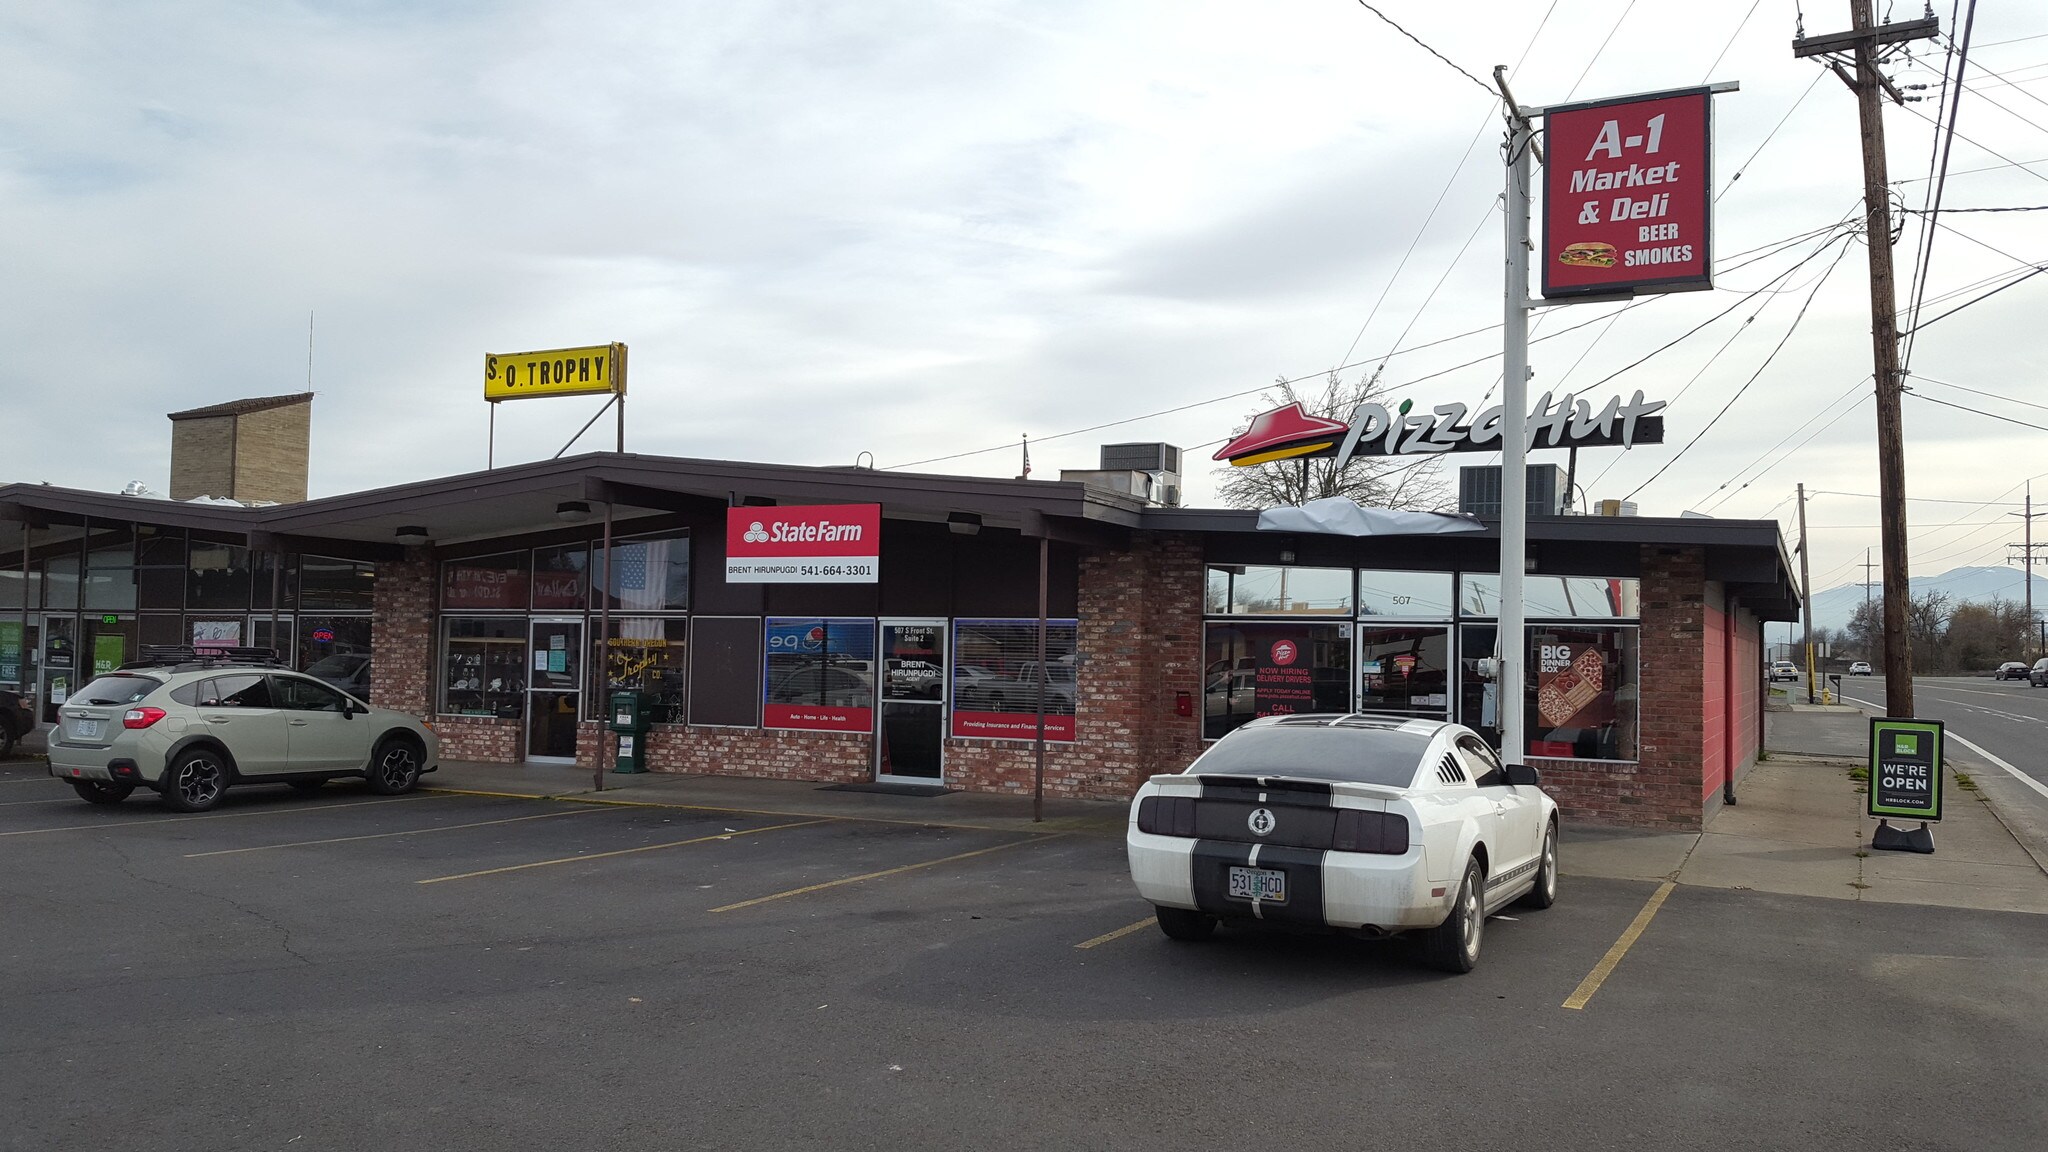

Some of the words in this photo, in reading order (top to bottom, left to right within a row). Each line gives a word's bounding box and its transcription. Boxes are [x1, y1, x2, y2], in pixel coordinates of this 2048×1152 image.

[1585, 114, 1666, 162] A-1
[1569, 161, 1681, 194] Market
[1578, 200, 1601, 225] &
[1610, 192, 1670, 222] Deli
[1639, 222, 1679, 243] BEER
[1624, 244, 1693, 267] SMOKES
[527, 356, 604, 386] TROPHY
[1336, 398, 1504, 469] Pizza
[1526, 389, 1667, 454] Hut
[728, 566, 752, 574] BRENT
[754, 566, 798, 574] HIRUNPUGDI
[800, 565, 872, 576] 541-664-3301
[1393, 596, 1411, 605] 507
[102, 615, 117, 624] OPEN
[312, 631, 335, 640] OPEN
[904, 634, 919, 642] Suite
[920, 634, 924, 642] 2
[607, 638, 640, 647] SOUTHERN
[642, 638, 667, 648] OREGON
[1541, 645, 1571, 660] BIG
[95, 660, 112, 669] H&R
[616, 652, 657, 681] Trophy
[901, 660, 926, 668] BRENT
[1541, 659, 1571, 667] DINNER
[2, 665, 16, 676] FREE
[891, 669, 936, 677] HIRUNPUGDI
[1259, 667, 1279, 675] NOW
[1280, 668, 1308, 676] HIRING
[1285, 675, 1312, 684] DRIVERS
[1271, 703, 1295, 713] CALL
[963, 721, 985, 729] Providing
[1882, 763, 1927, 776] WE'RE
[1882, 777, 1927, 790] OPEN
[1232, 874, 1251, 890] 531
[1260, 876, 1282, 893] HCD
